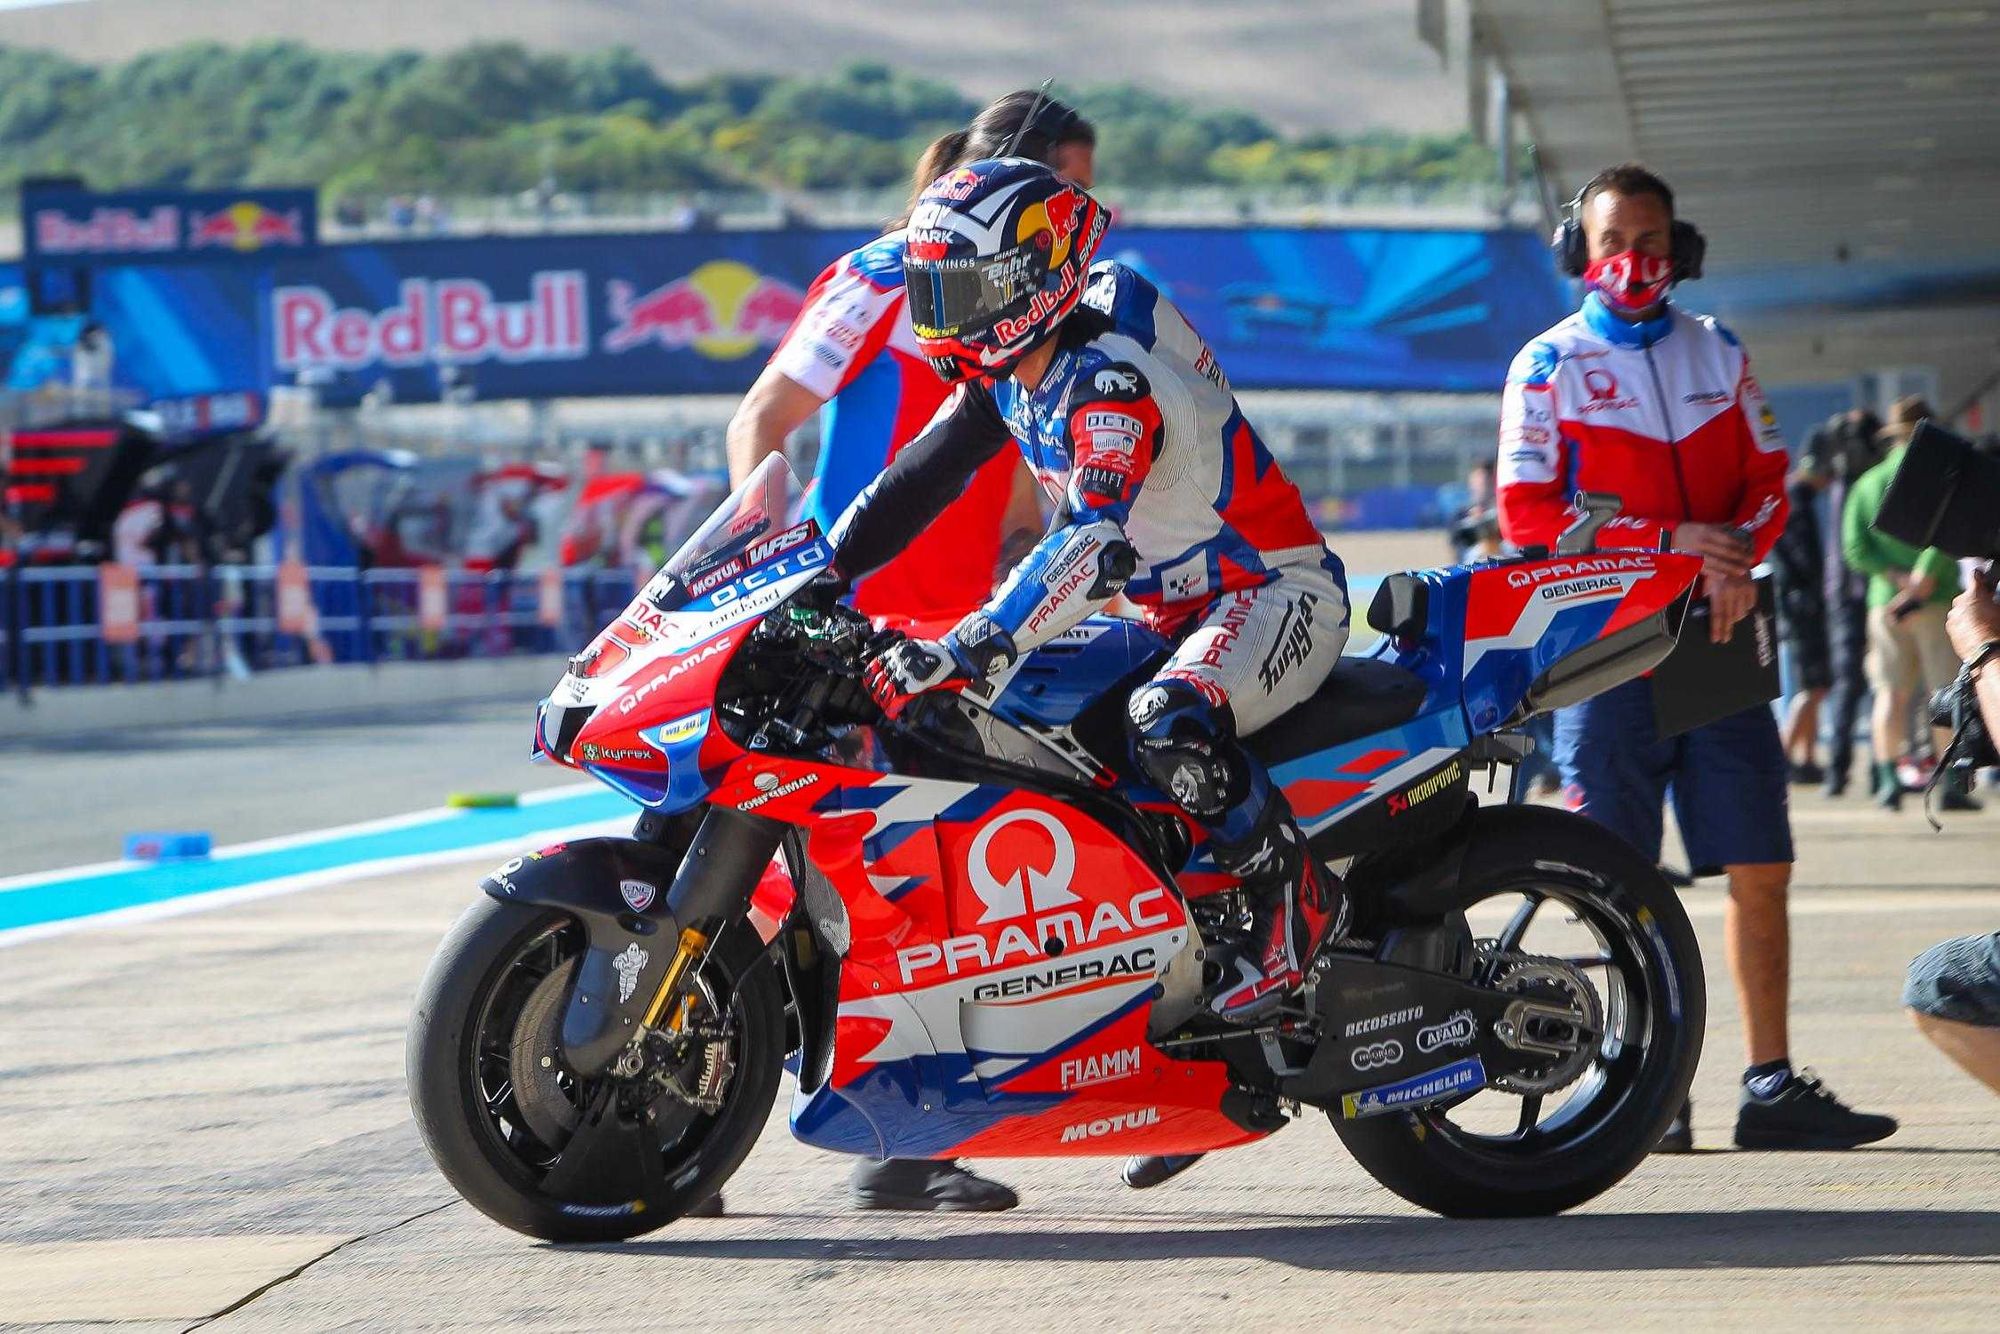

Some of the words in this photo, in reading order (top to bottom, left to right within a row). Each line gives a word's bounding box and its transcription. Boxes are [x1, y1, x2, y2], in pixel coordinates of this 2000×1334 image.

[935, 257, 976, 270] WINGS
[274, 278, 428, 369] Red
[431, 270, 587, 364] Bull
[993, 293, 1046, 347] Red
[1087, 414, 1142, 438] OCTO
[1084, 466, 1124, 488] CRAFT
[1046, 533, 1097, 584] GENERAC
[1531, 555, 1656, 582] PRAMAC
[692, 560, 741, 598] MOTUL
[1541, 575, 1621, 600] GENERAC
[1027, 563, 1096, 634] PRAMAC
[635, 635, 732, 703] PRAMAC
[896, 887, 1169, 986] PRAMAC
[973, 947, 1157, 1001] GENERAC
[1427, 1022, 1465, 1047] AFAM
[1060, 1046, 1140, 1084] FIAMM
[1386, 1068, 1473, 1104] MICHELIN
[1060, 1107, 1161, 1143] MOTUL
